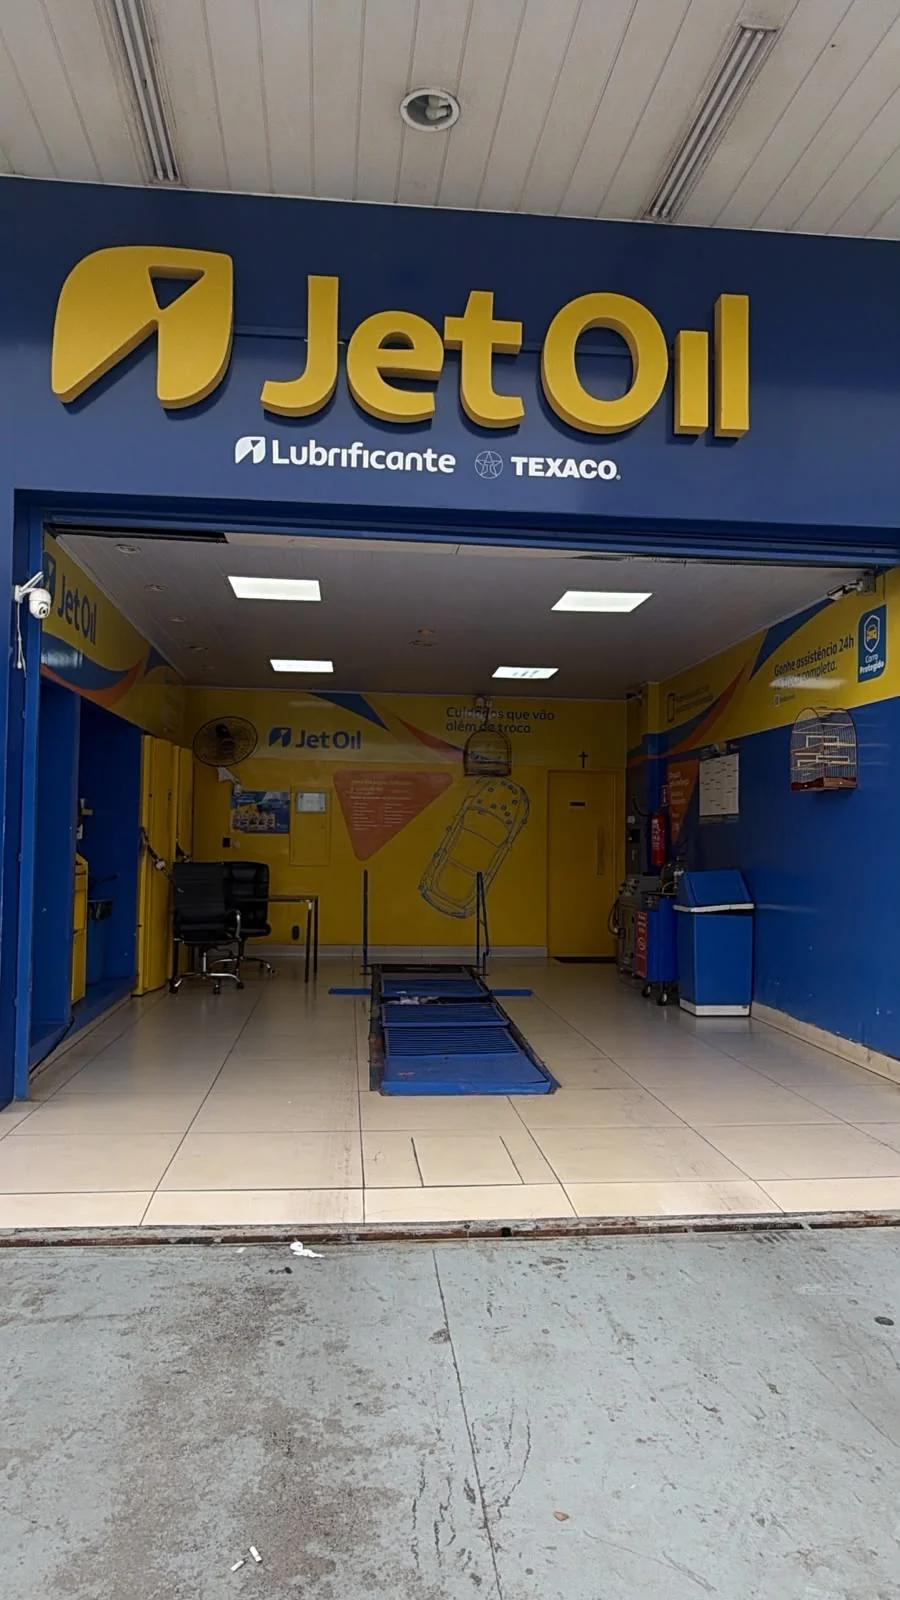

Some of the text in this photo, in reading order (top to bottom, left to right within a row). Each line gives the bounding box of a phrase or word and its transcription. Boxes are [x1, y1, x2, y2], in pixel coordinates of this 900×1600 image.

[272, 439, 457, 474] Lubrificante
[510, 456, 617, 481] TEXACO
[774, 659, 796, 677] Ganhe
[839, 633, 854, 653] 24h
[865, 653, 879, 664] Carro
[859, 659, 885, 675] Protegido
[507, 711, 530, 720] que
[532, 709, 555, 720] vão
[446, 720, 477, 732] além
